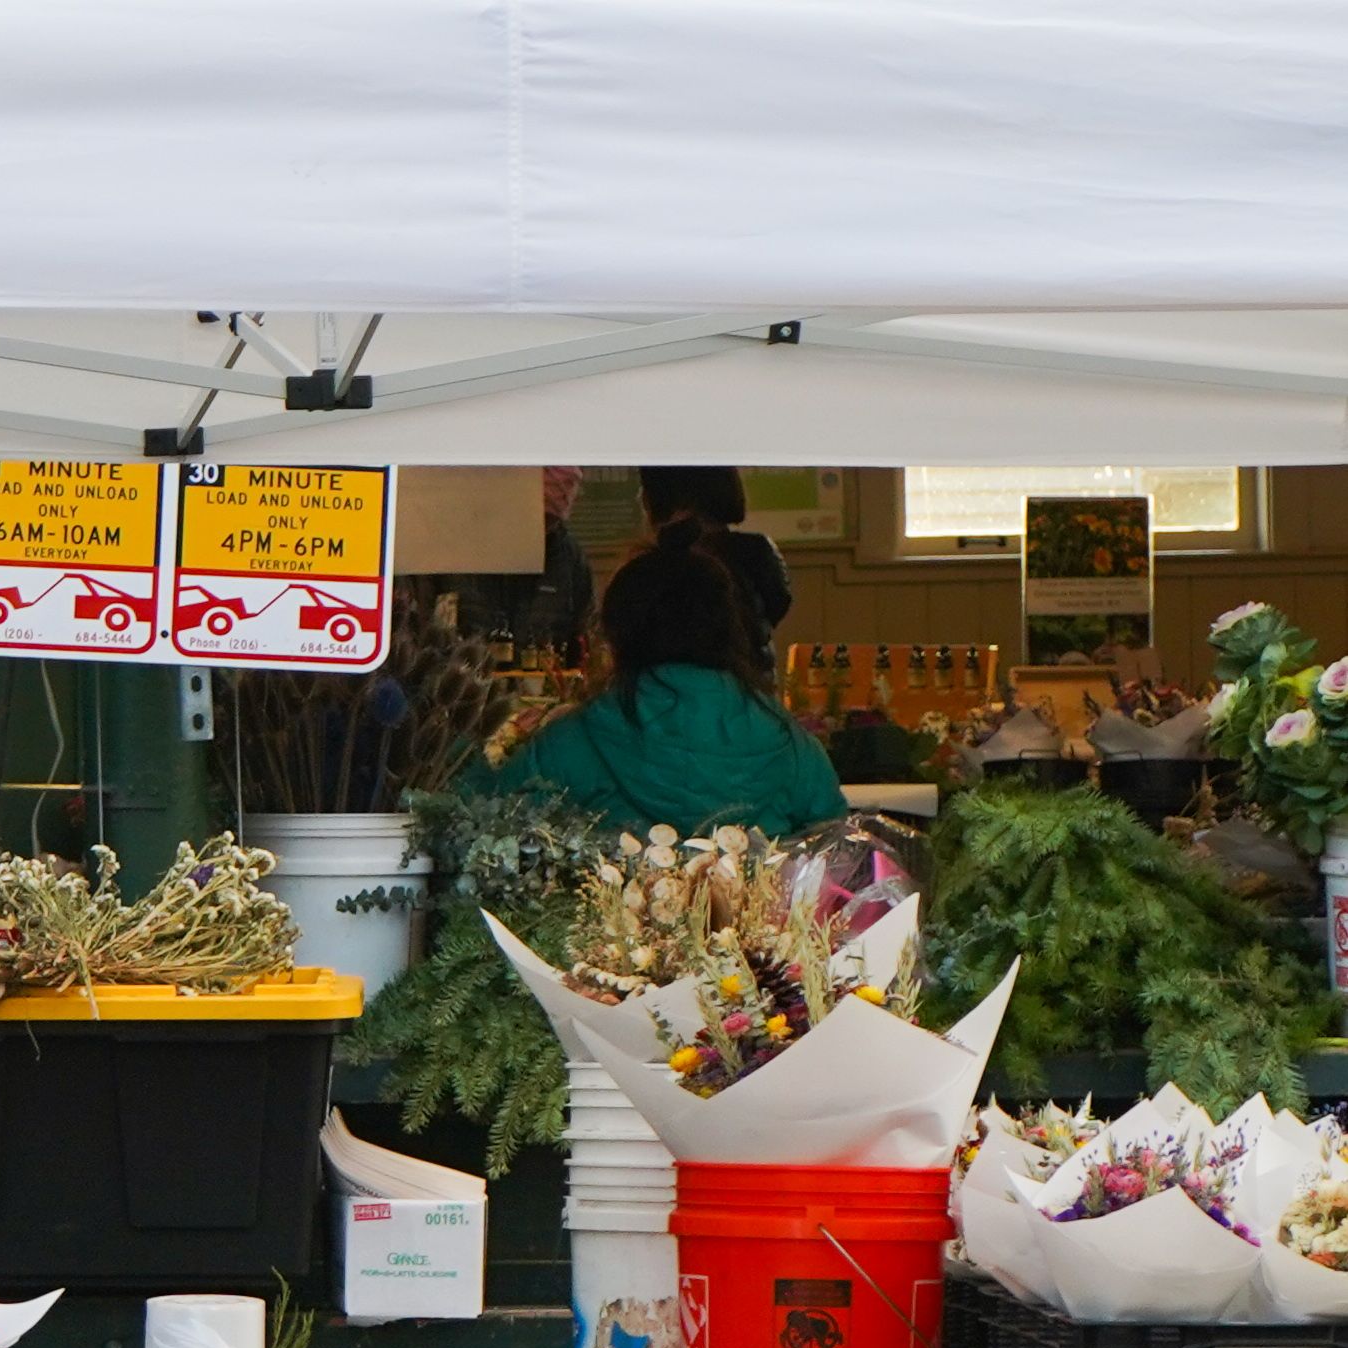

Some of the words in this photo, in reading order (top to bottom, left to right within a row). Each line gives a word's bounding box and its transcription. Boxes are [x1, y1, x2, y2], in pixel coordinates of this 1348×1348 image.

[29, 461, 123, 480] MINUTE
[189, 463, 219, 484] 30
[249, 470, 343, 491] MINUTE
[33, 484, 64, 497] AND
[76, 485, 138, 500] UNLOAD
[206, 491, 247, 505] LOAD
[258, 494, 290, 507] AND
[301, 496, 363, 510] UNLOAD
[39, 504, 78, 518] ONLY
[268, 516, 308, 529] ONLY
[25, 547, 87, 560] EVERYDAY
[250, 558, 313, 571] EVERYDAY
[75, 632, 132, 644] 684-5444
[189, 637, 220, 648] Phone
[300, 643, 357, 655] 684-5444
